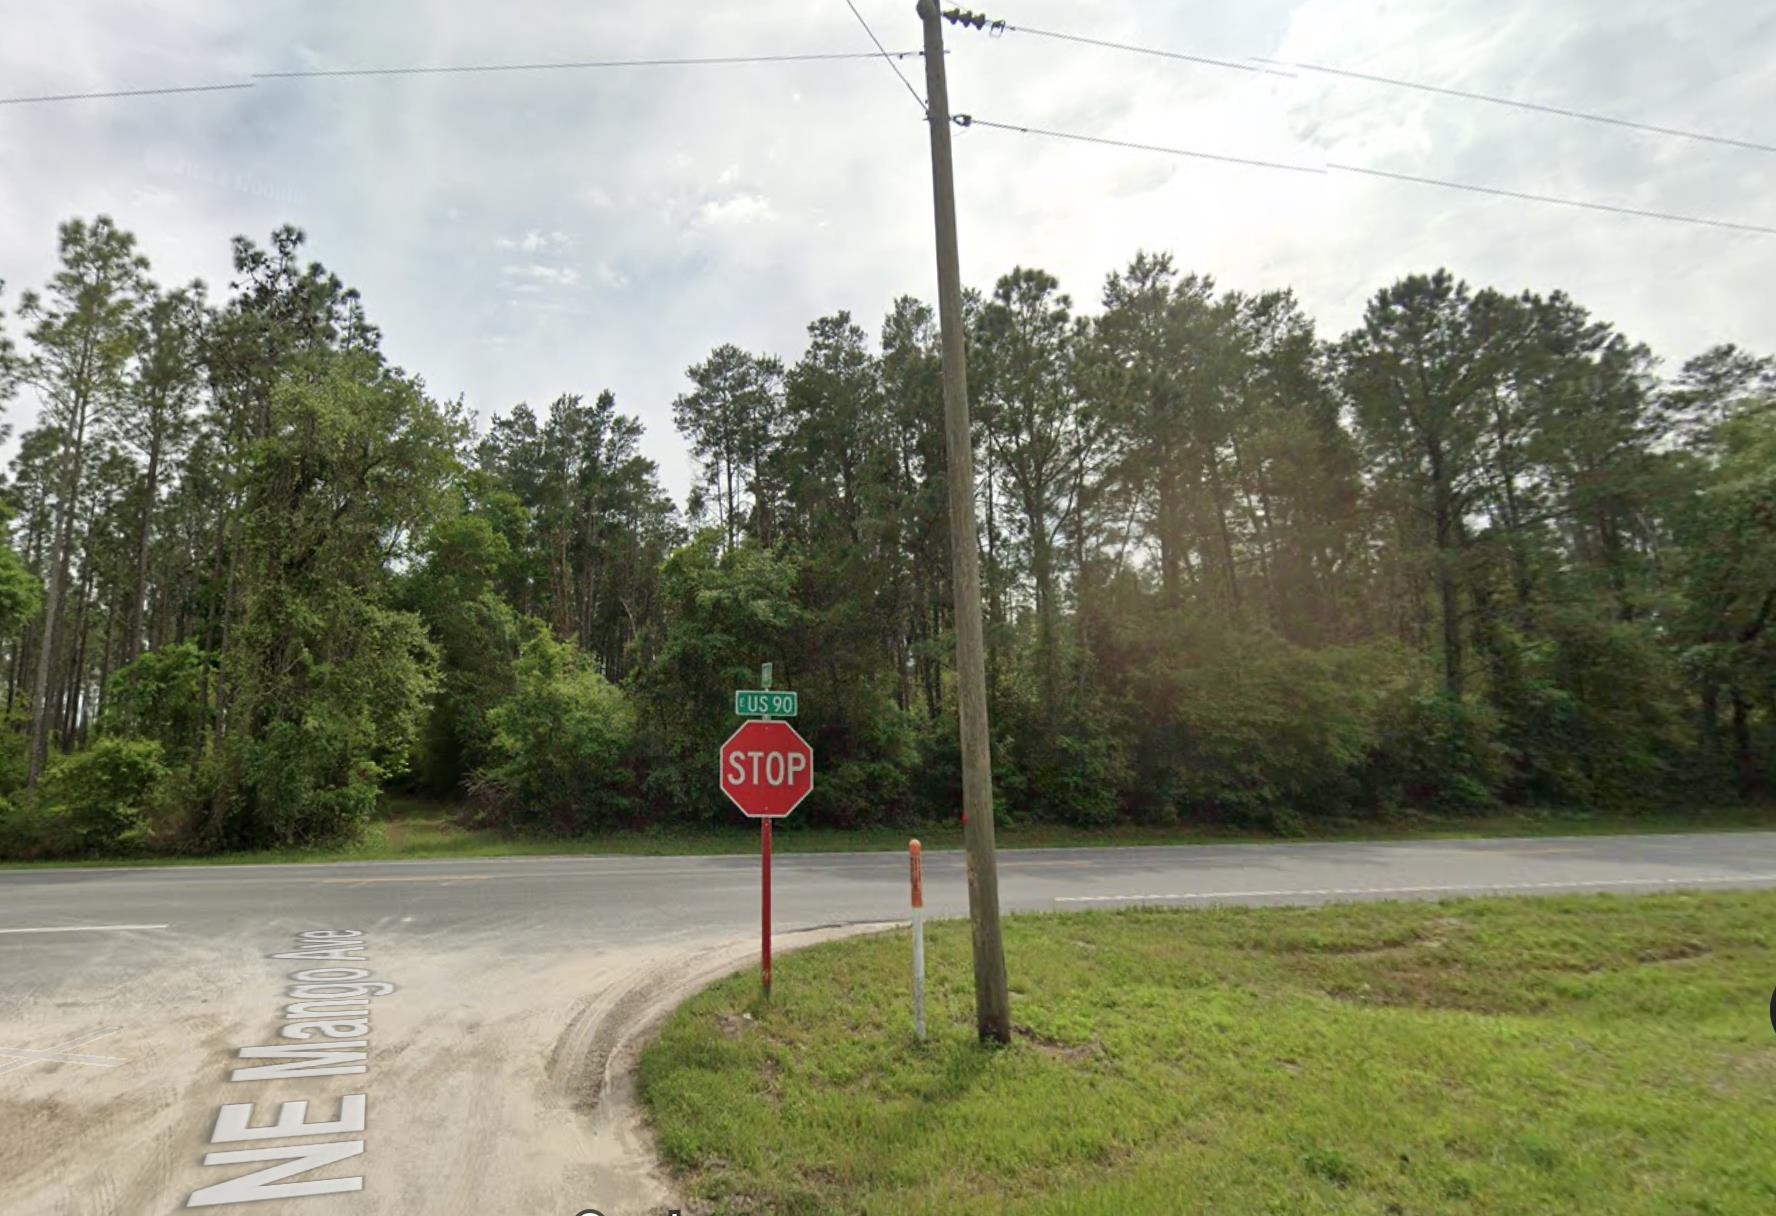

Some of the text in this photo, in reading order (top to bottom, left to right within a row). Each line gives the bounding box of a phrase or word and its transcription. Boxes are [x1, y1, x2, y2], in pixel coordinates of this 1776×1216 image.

[748, 695, 768, 712] US
[773, 696, 793, 713] 90
[727, 751, 806, 786] STOP
